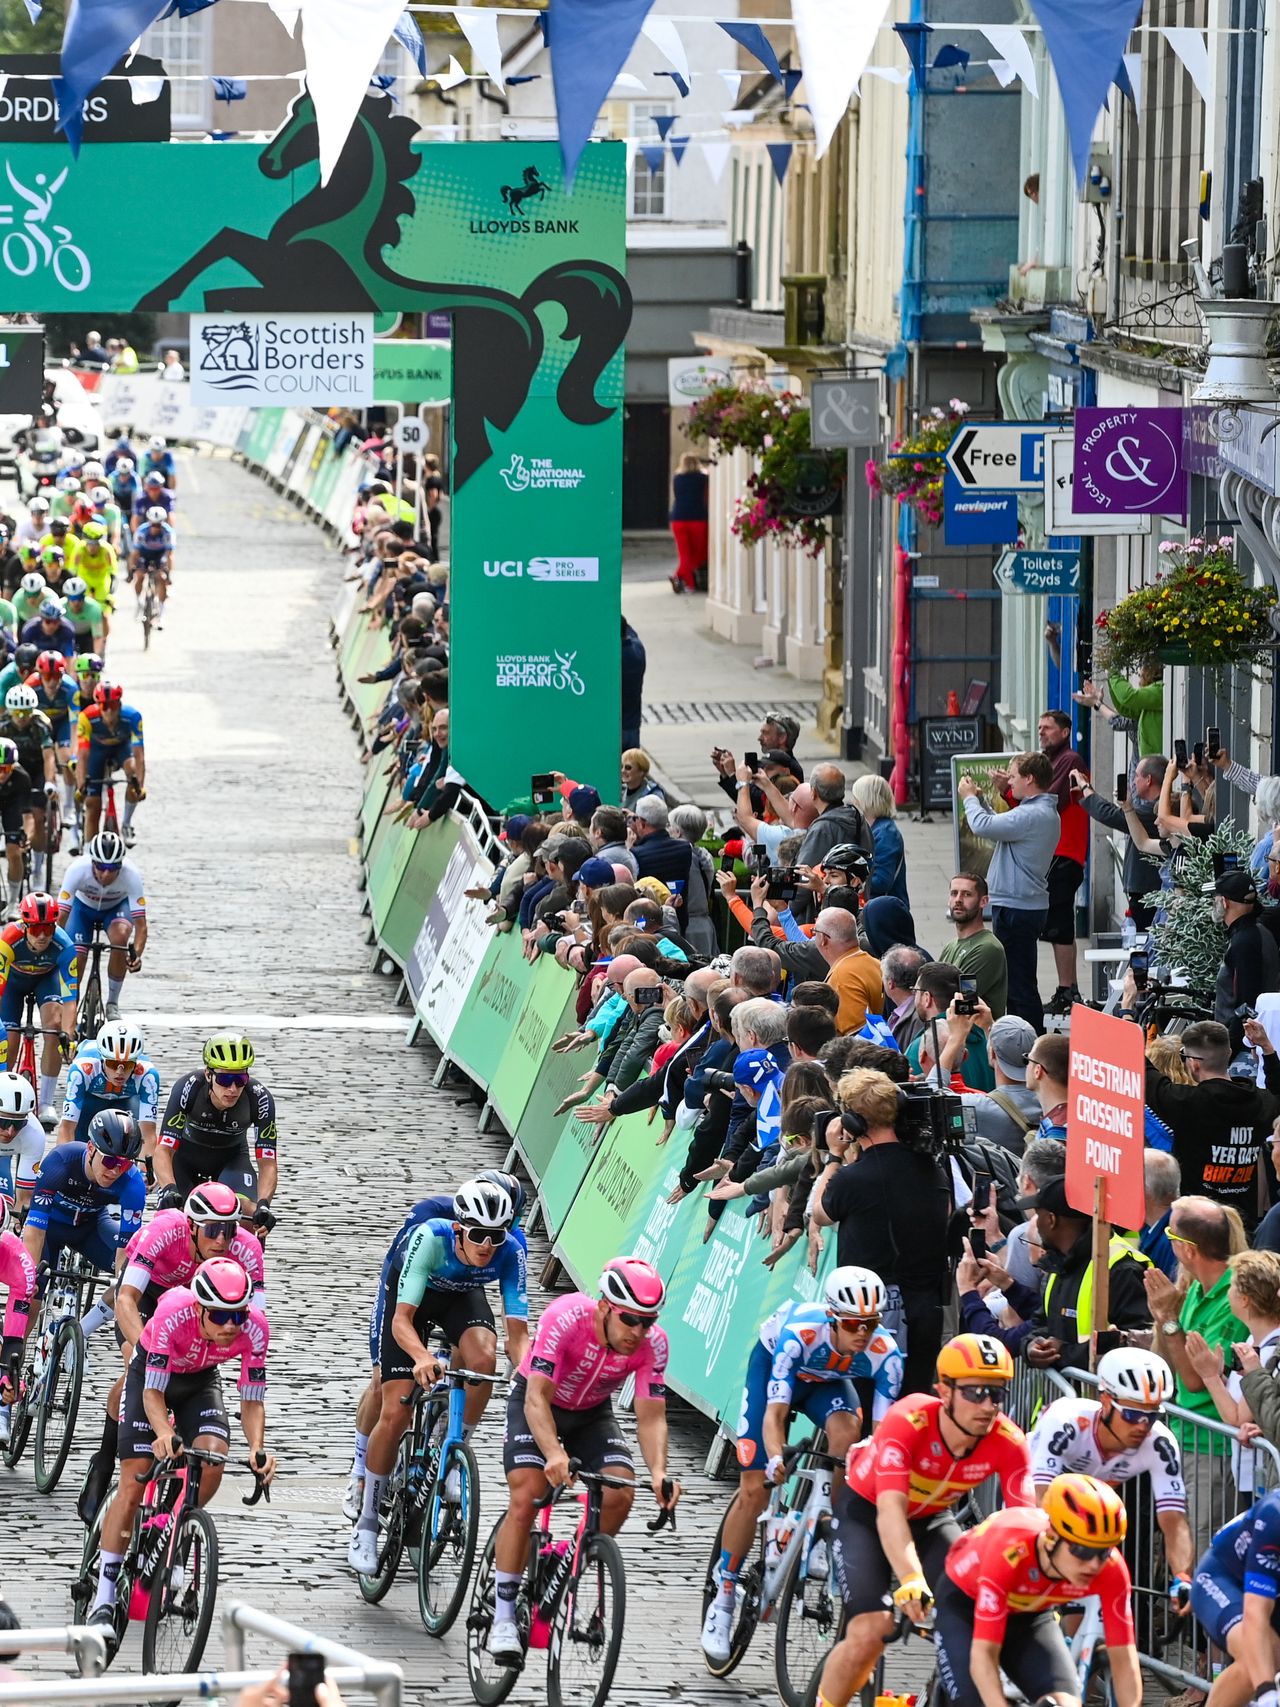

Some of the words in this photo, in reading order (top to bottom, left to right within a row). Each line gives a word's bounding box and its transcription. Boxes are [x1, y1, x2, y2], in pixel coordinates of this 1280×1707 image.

[470, 221, 531, 233] LLOYDS
[534, 221, 580, 233] BANK
[264, 320, 365, 344] Scottish
[264, 347, 364, 370] Borders
[264, 374, 364, 392] COUNCIL
[402, 426, 420, 442] 50
[1082, 412, 1139, 453] PROPERTY
[530, 459, 552, 468] THE
[969, 449, 1017, 467] Free
[530, 469, 585, 478] NATIONAL
[530, 479, 579, 488] LOTTERY
[1081, 472, 1112, 509] LEGAL
[953, 499, 1009, 513] nevisport
[483, 561, 523, 577] UCI
[1021, 556, 1064, 571] Toilets
[1023, 572, 1061, 587] 72yds
[496, 663, 536, 675] TOUR
[536, 663, 557, 675] OF
[496, 675, 551, 687] BRITAIN
[931, 730, 974, 742] WYND
[1071, 1050, 1141, 1100] PEDESTRIAN
[258, 1095, 270, 1120] UBS
[1076, 1094, 1133, 1139] CROSSING
[1230, 1126, 1254, 1145] NOT
[1085, 1138, 1122, 1175] POINT
[1211, 1145, 1237, 1165] YER
[147, 1241, 165, 1258] VAN
[402, 1233, 425, 1281] DECATHLON
[157, 1326, 169, 1350] VAN
[164, 1306, 197, 1333] RYSEL
[544, 1327, 560, 1356] VAN
[559, 1304, 589, 1331] RYSEL
[555, 1379, 575, 1403] VAN
[572, 1342, 601, 1386] RYSEL
[414, 1484, 431, 1509] VAN
[143, 1552, 161, 1578] VAN
[543, 1576, 561, 1605] VAN
